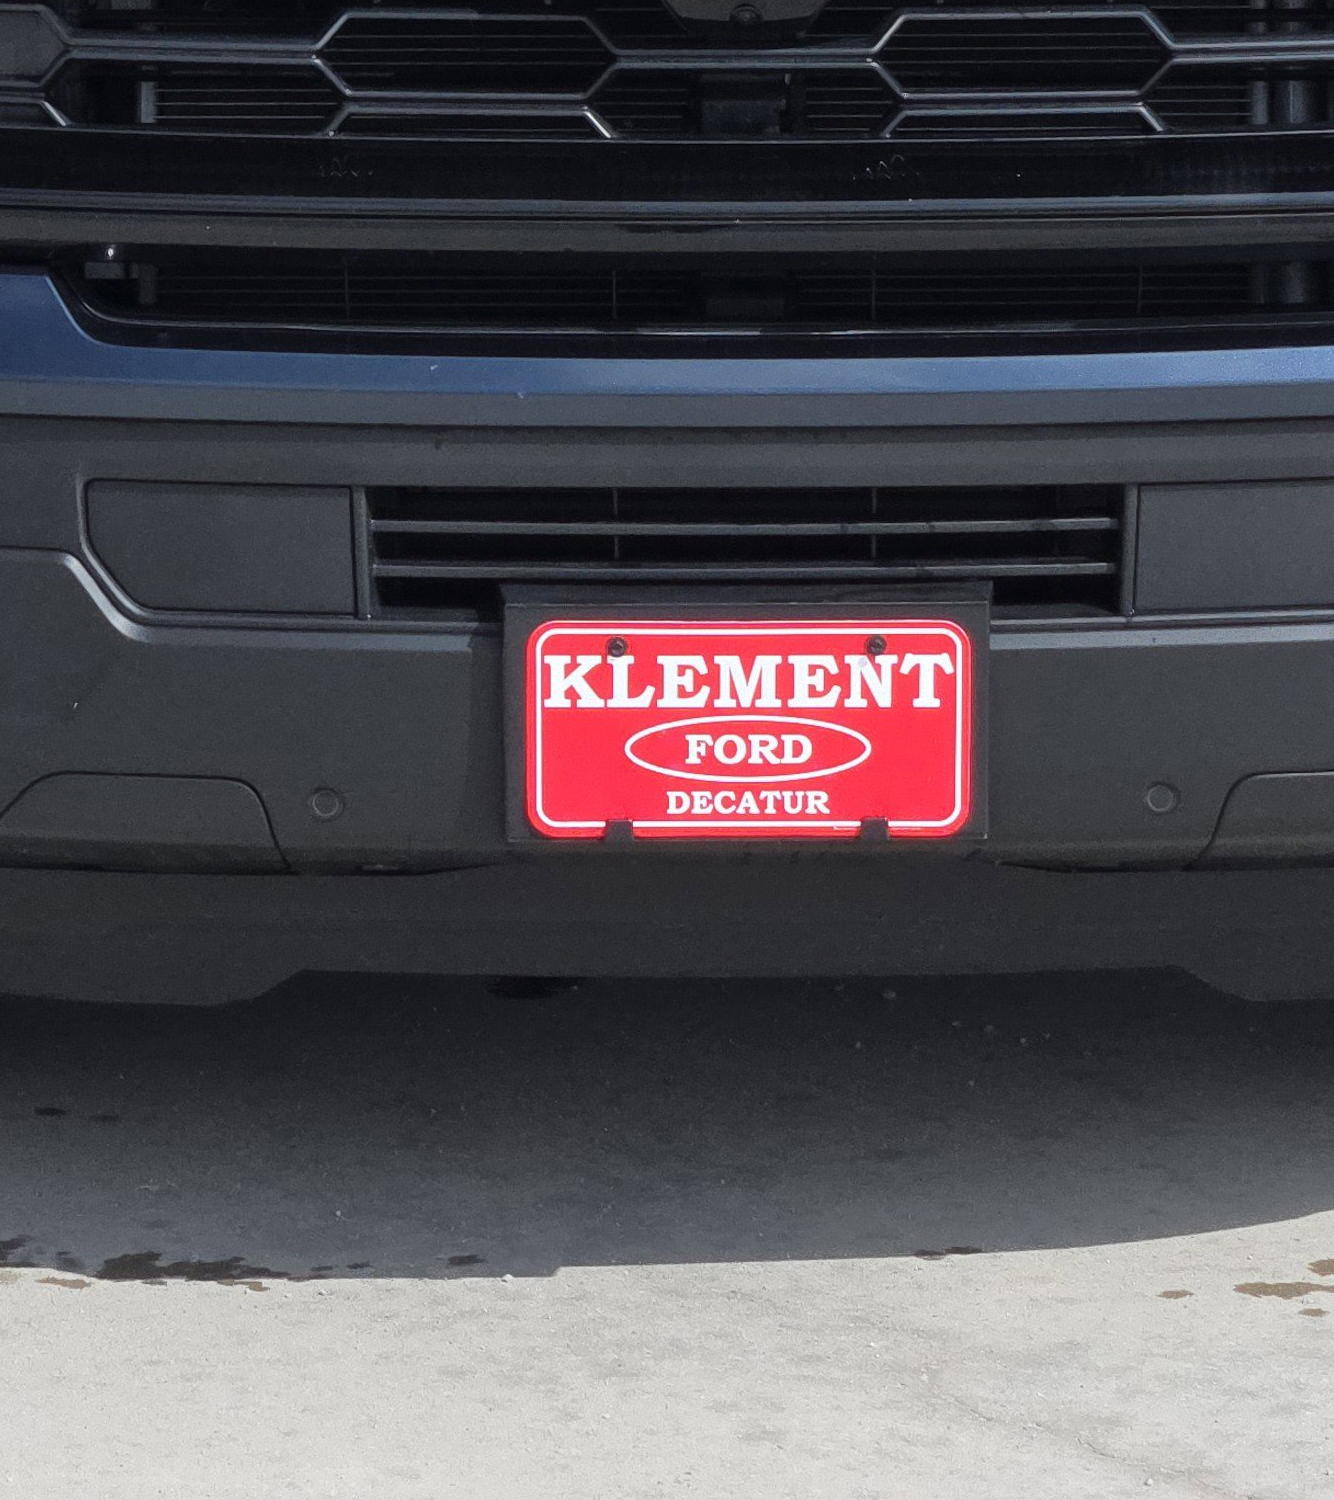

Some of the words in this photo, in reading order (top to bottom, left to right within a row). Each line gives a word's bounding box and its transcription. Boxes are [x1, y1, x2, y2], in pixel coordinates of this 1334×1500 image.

[543, 653, 955, 708] KLEMENT
[685, 734, 813, 764] FORD
[666, 791, 830, 815] DECATUR
